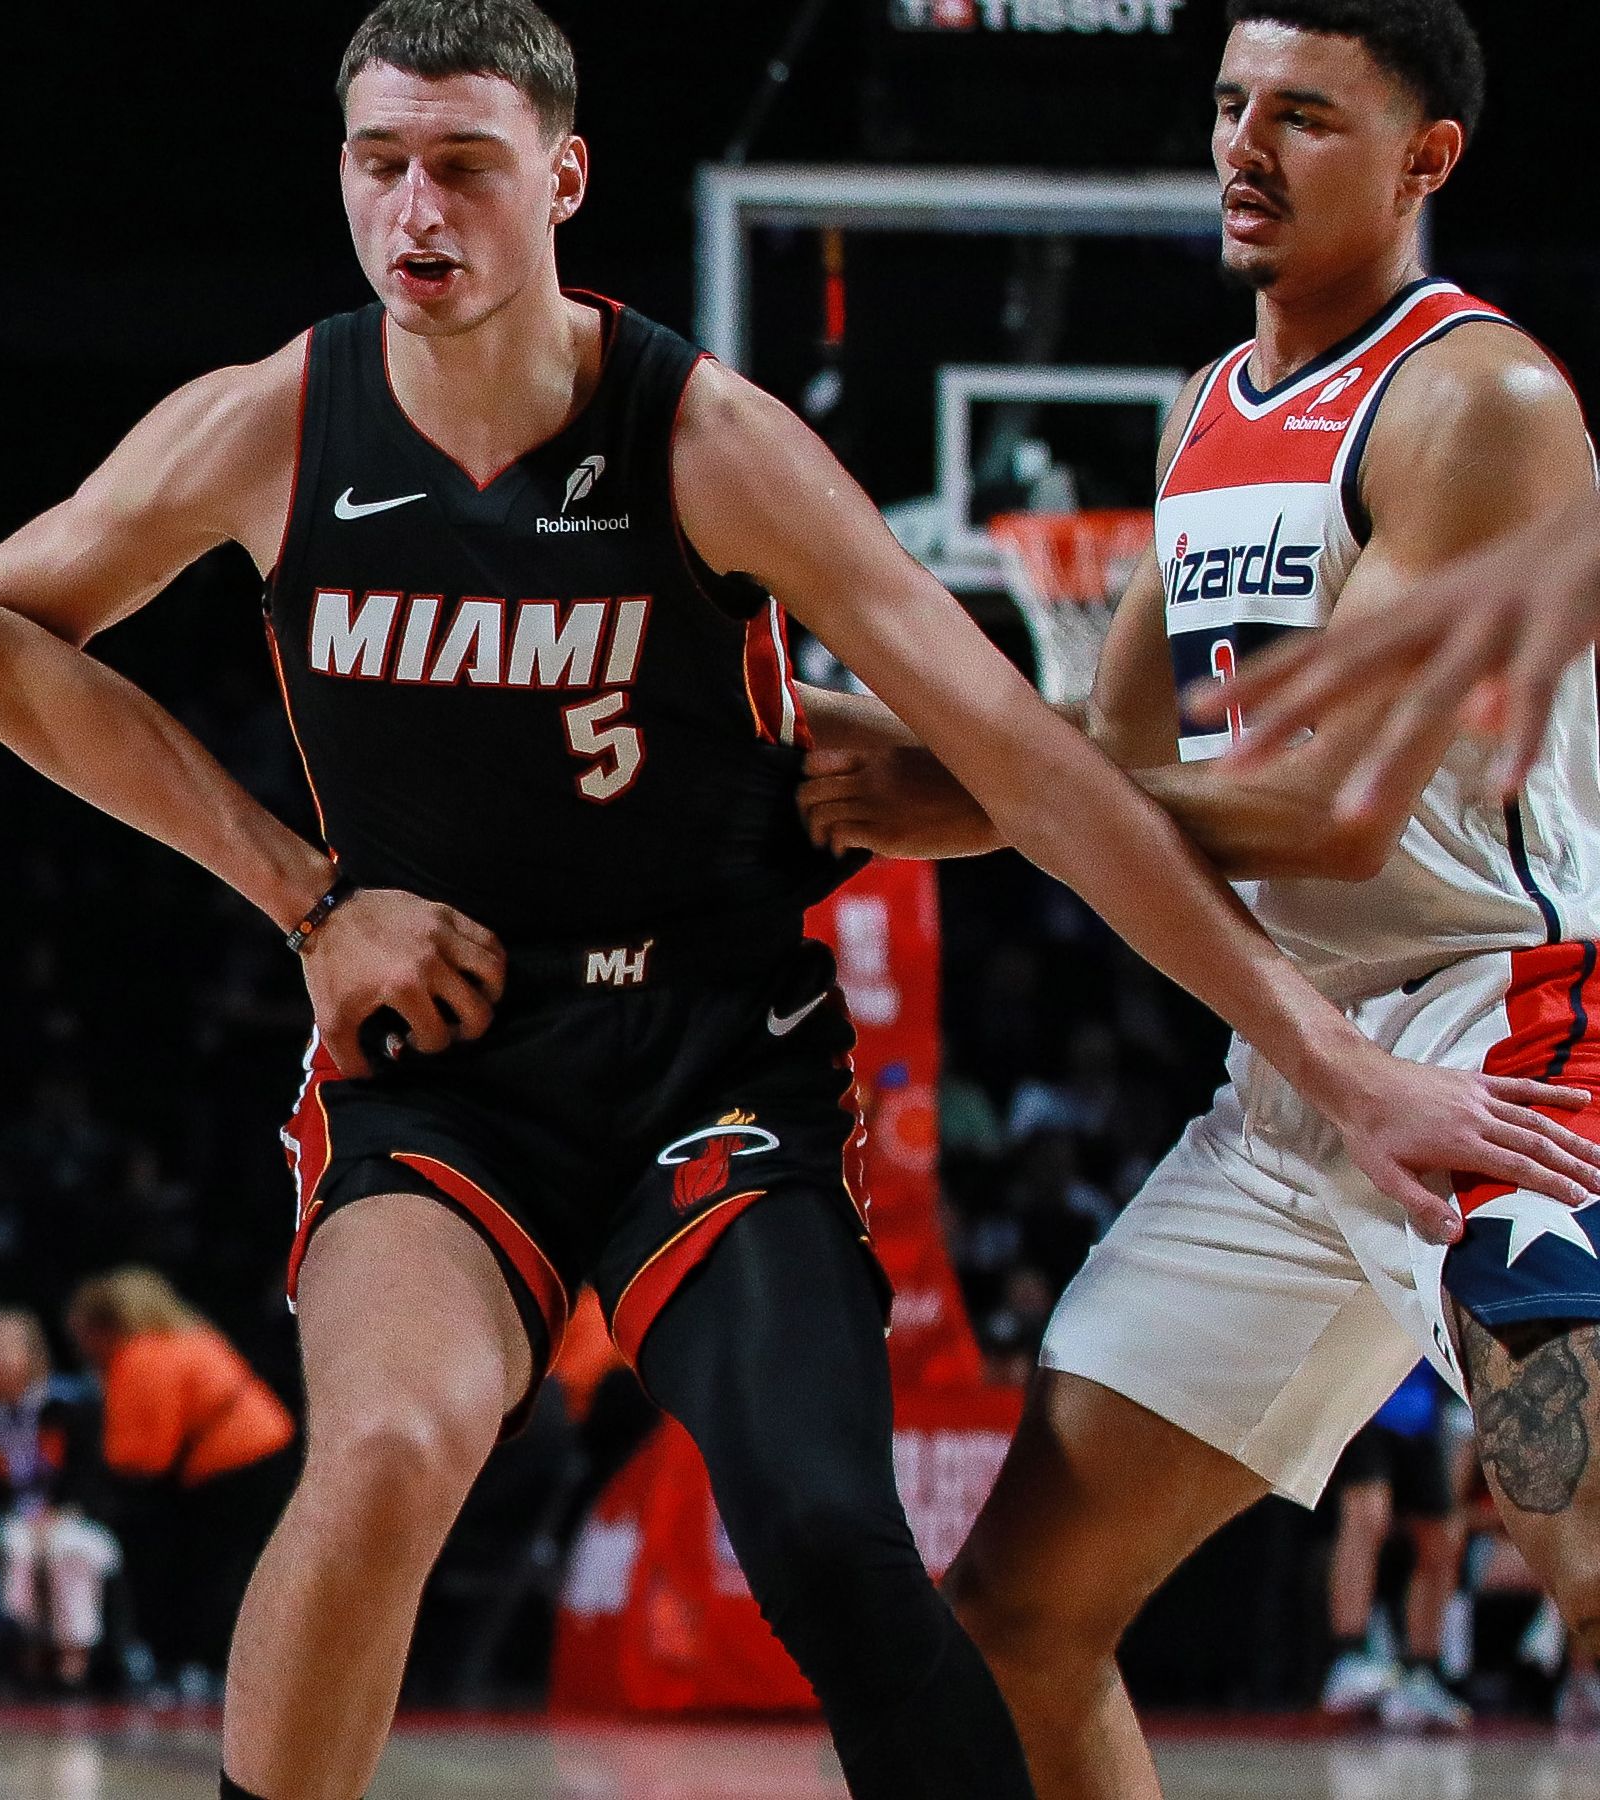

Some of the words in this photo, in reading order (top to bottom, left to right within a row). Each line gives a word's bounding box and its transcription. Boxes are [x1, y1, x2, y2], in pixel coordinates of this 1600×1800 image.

[1282, 415, 1351, 432] Robinhood
[536, 513, 629, 534] Robinhood
[309, 589, 650, 687] MIAMI
[562, 691, 645, 803] 5
